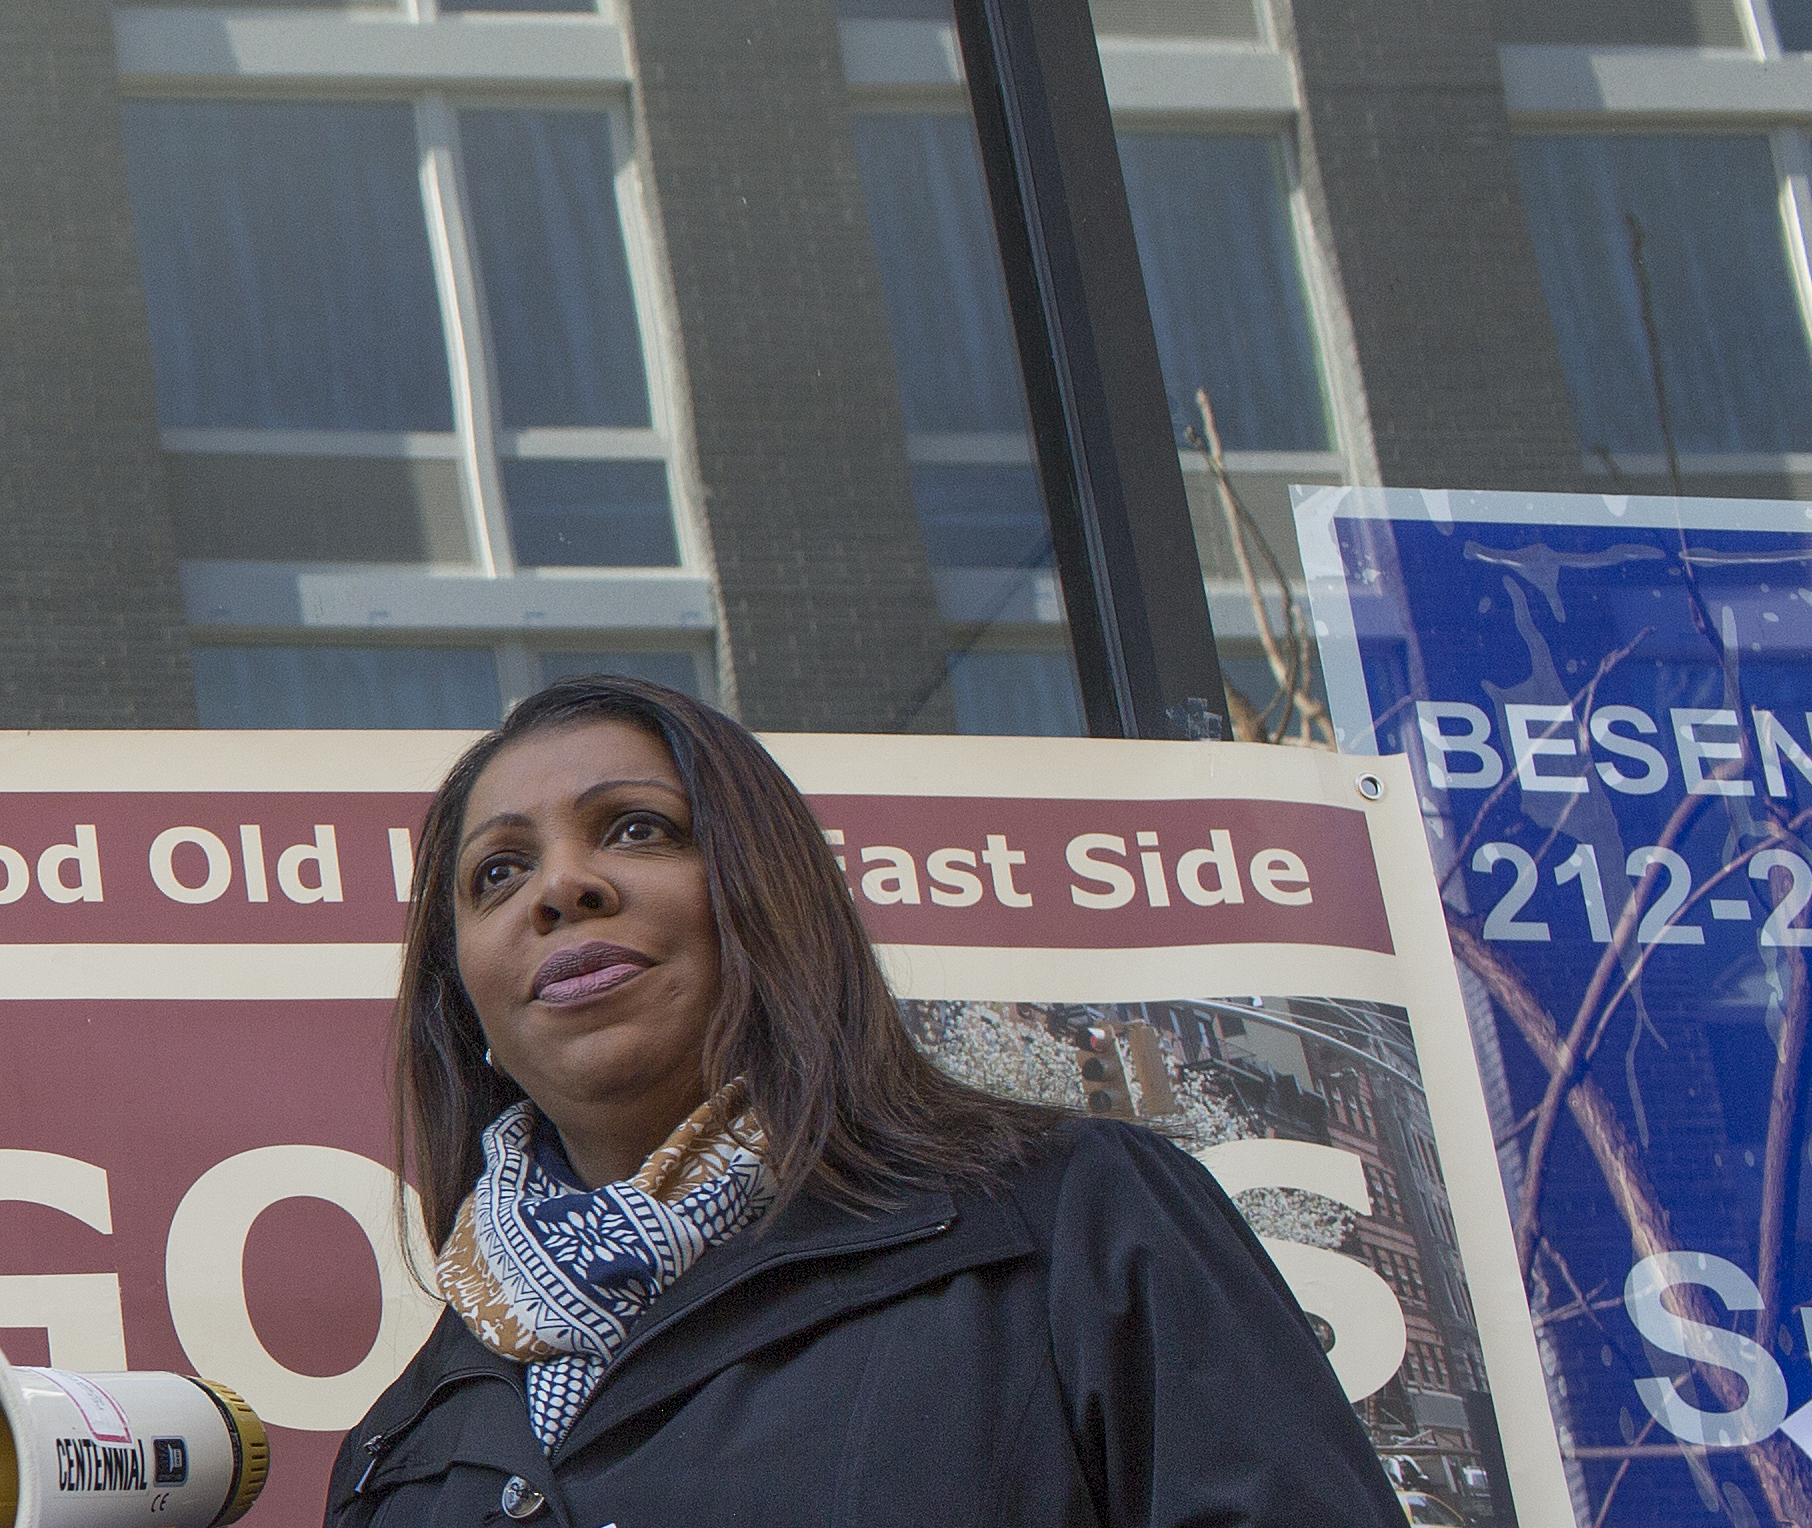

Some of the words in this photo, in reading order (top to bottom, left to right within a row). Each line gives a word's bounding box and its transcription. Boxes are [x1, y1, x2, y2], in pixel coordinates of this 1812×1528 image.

[149, 824, 345, 905] Old
[1065, 828, 1314, 910] Side
[56, 1438, 148, 1492] CENTENNIAL
